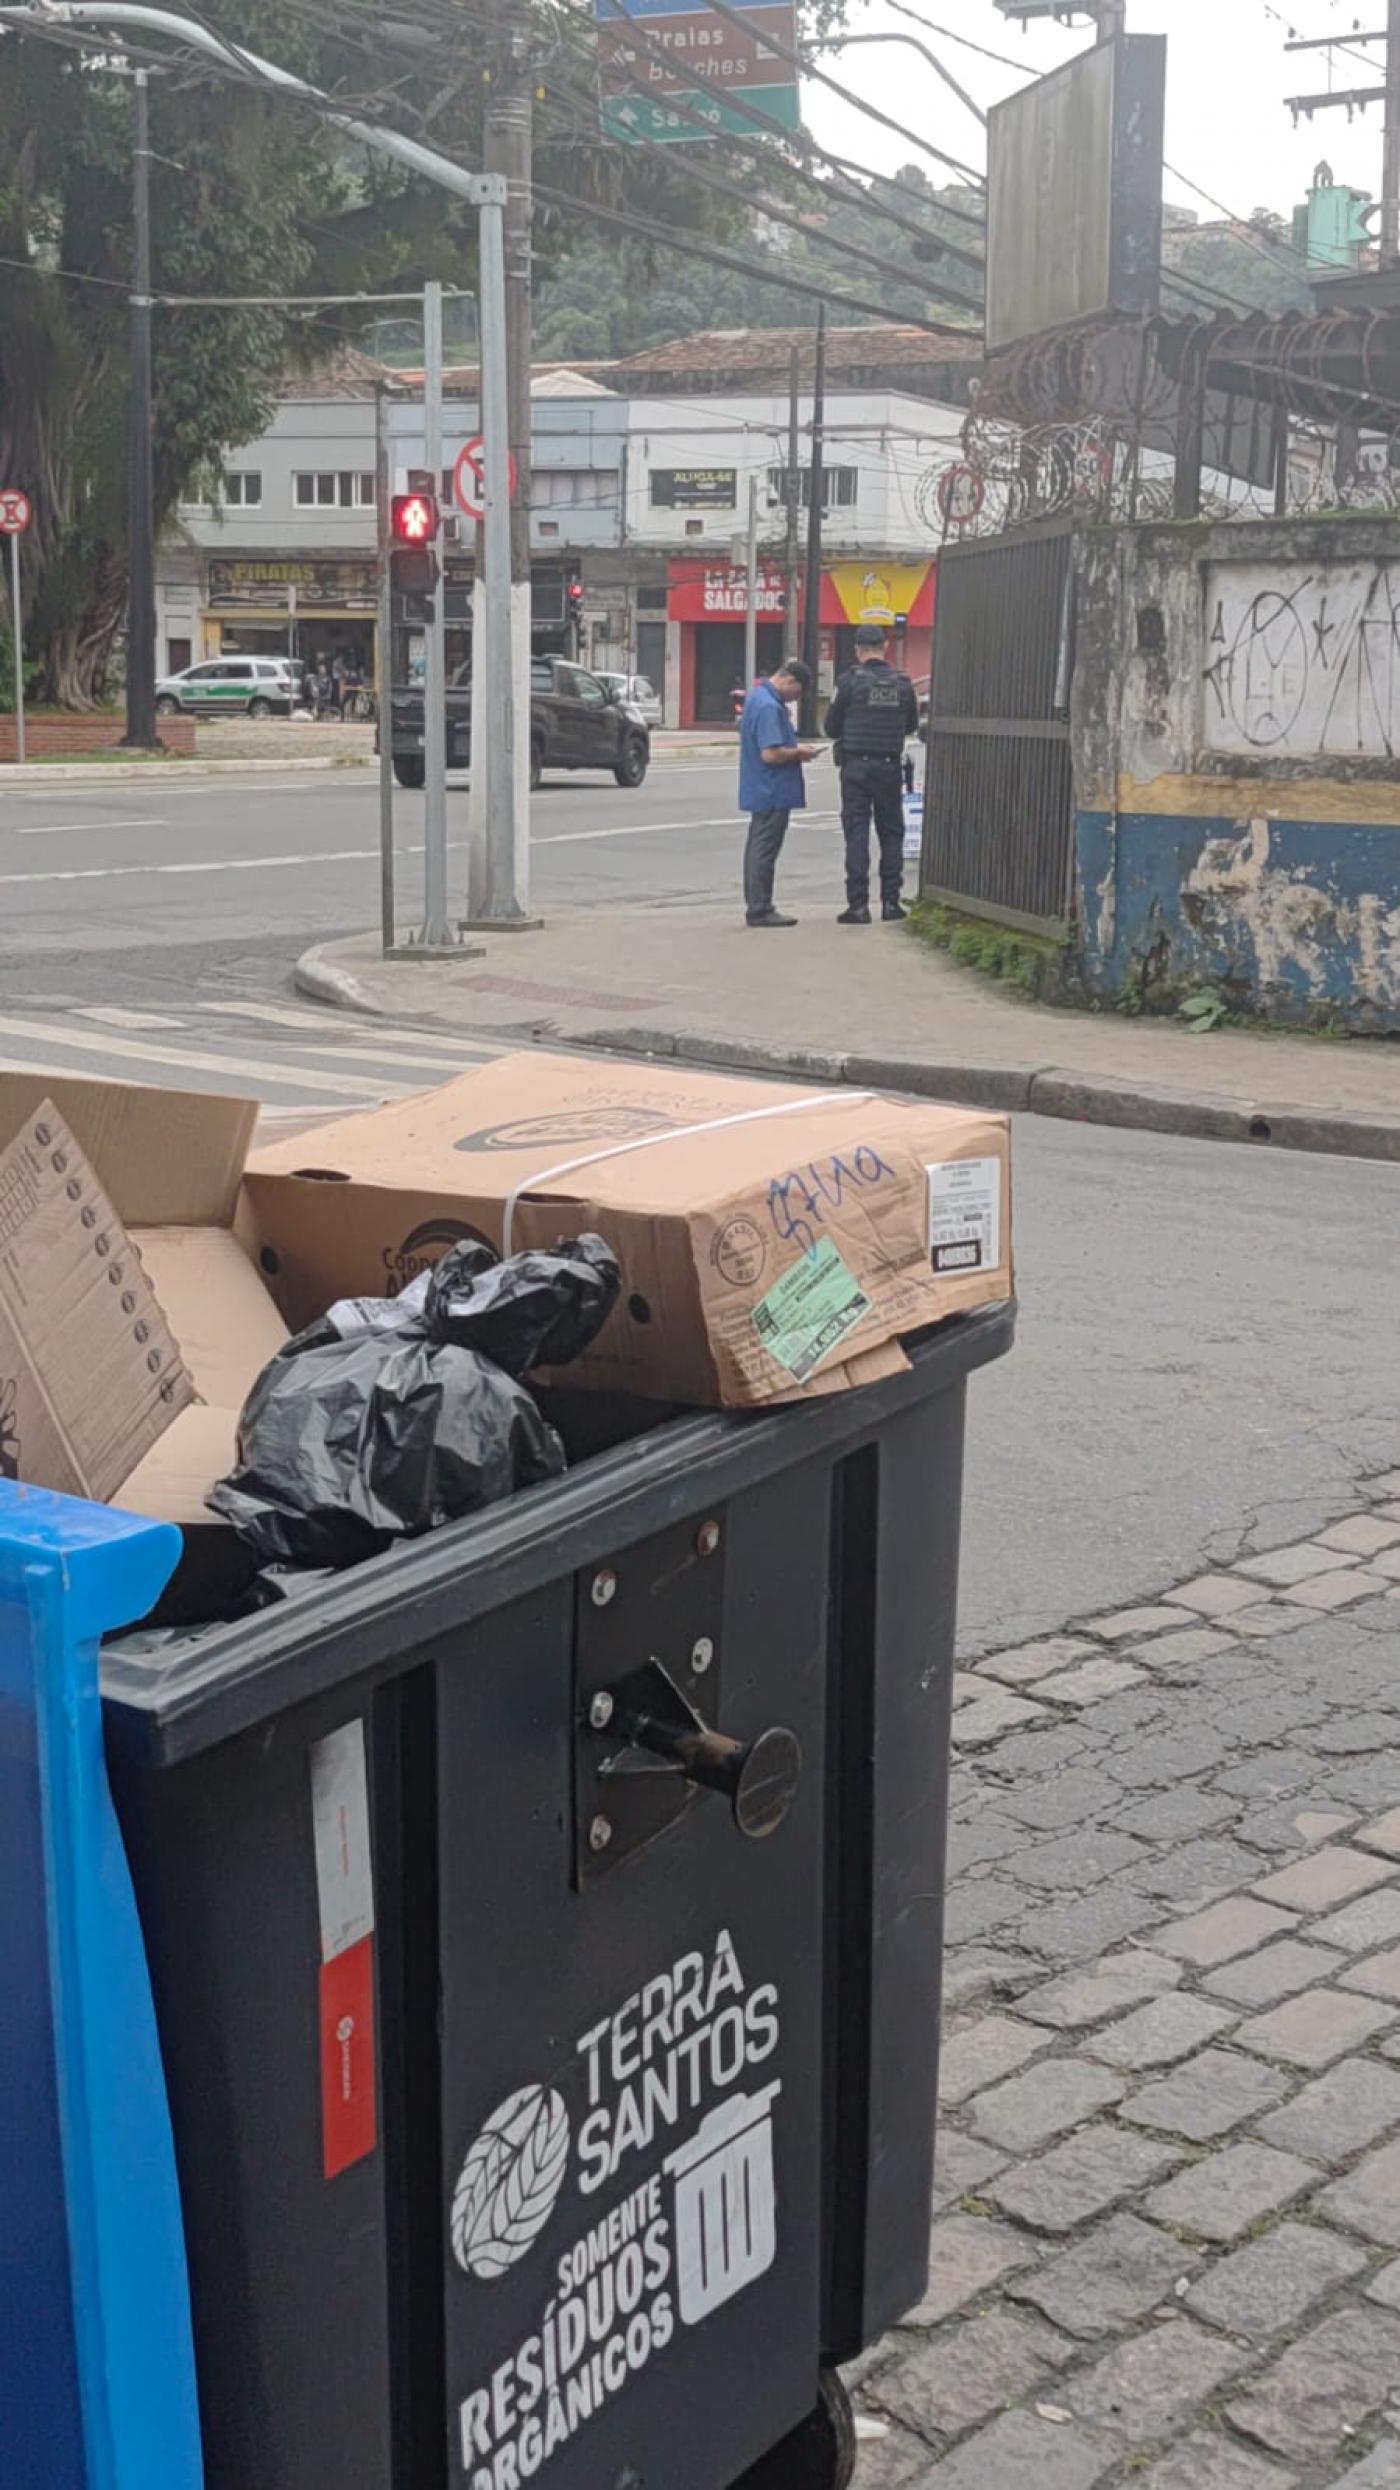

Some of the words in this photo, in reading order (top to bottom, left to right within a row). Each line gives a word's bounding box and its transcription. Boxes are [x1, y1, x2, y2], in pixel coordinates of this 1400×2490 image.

[577, 1928, 744, 2105] TERRA
[577, 1984, 778, 2194] SANTOS
[558, 2173, 661, 2299] SOMENTE
[460, 2218, 671, 2469] RESÍDUOS
